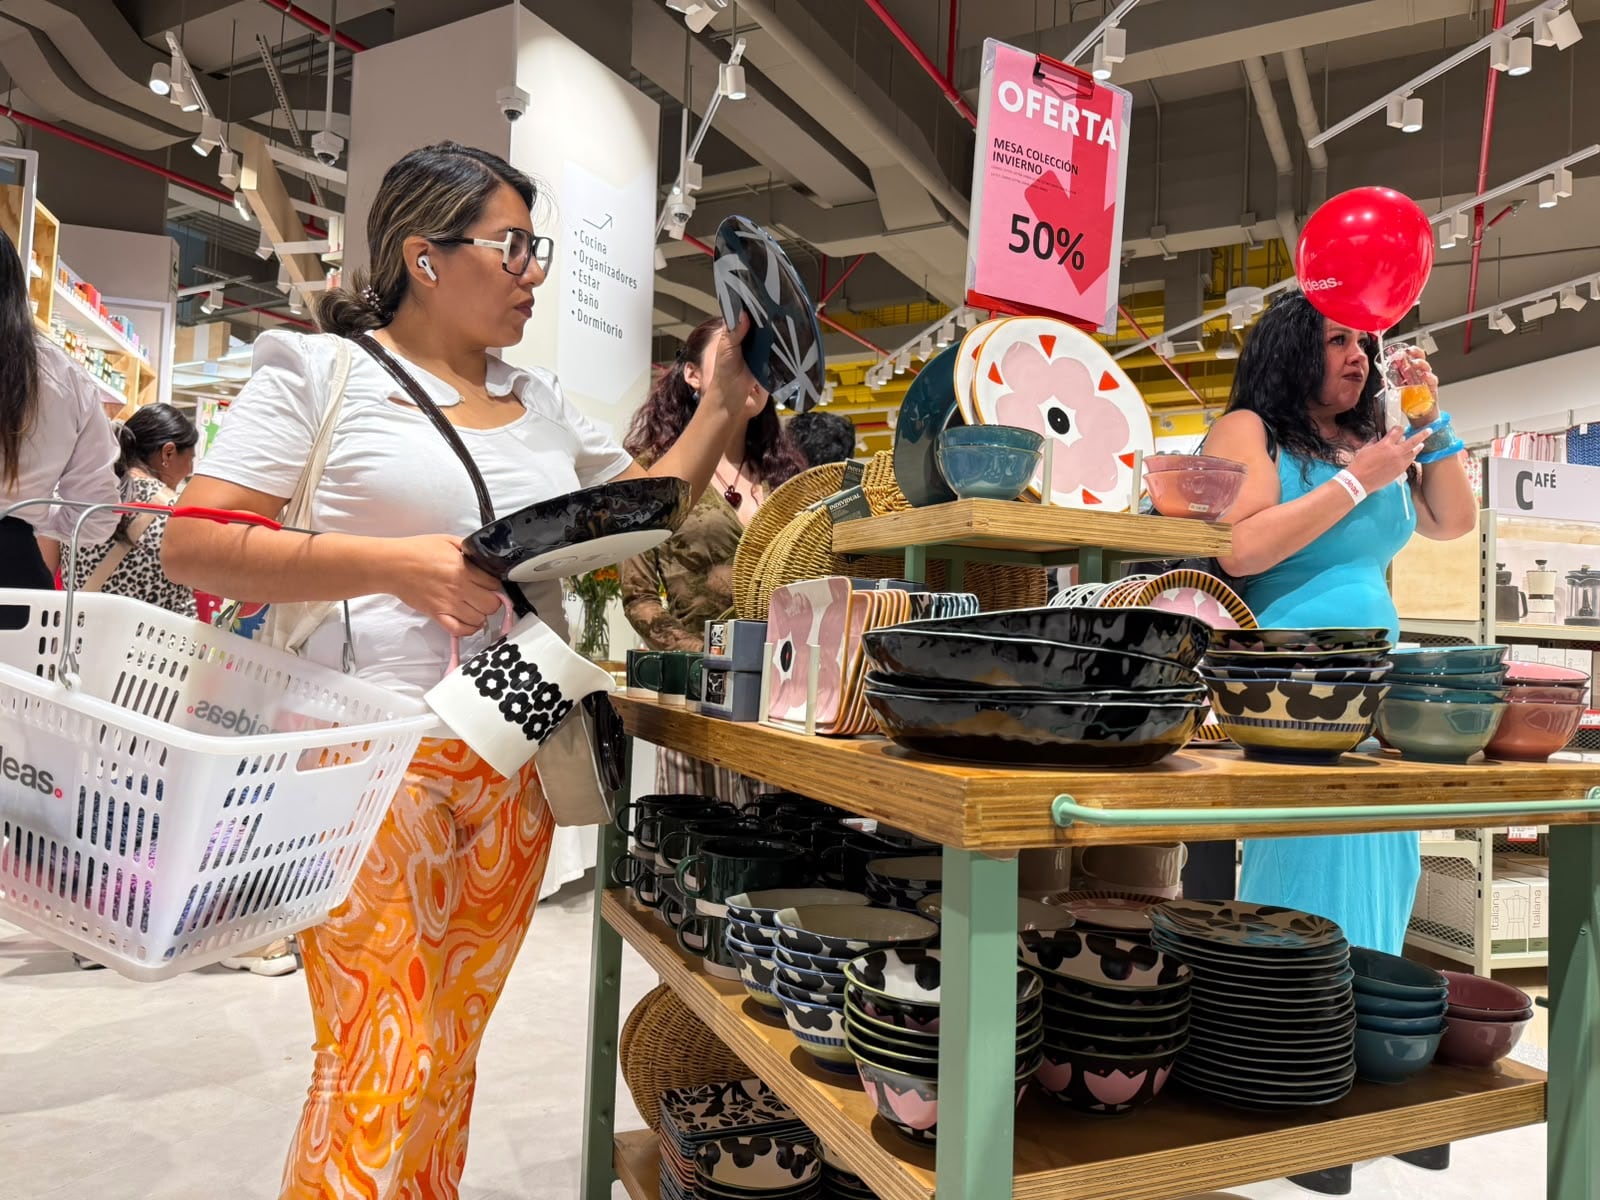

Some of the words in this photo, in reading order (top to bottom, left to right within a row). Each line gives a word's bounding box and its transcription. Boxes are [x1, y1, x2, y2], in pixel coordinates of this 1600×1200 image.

[998, 80, 1117, 151] OFERTA
[992, 151, 1043, 175] INVIERNO
[993, 137, 1024, 156] MESA
[1026, 148, 1079, 176] COLECCIÓN
[579, 230, 607, 255] Cocina
[1008, 213, 1085, 271] 50%
[578, 269, 600, 290] Estar
[579, 249, 638, 290] Organizadores
[577, 288, 599, 310] Baño
[577, 308, 623, 339] Dormitorio
[1515, 468, 1557, 511] CAFÉ
[1490, 891, 1500, 931] Italiana
[1532, 889, 1542, 929] Italiana
